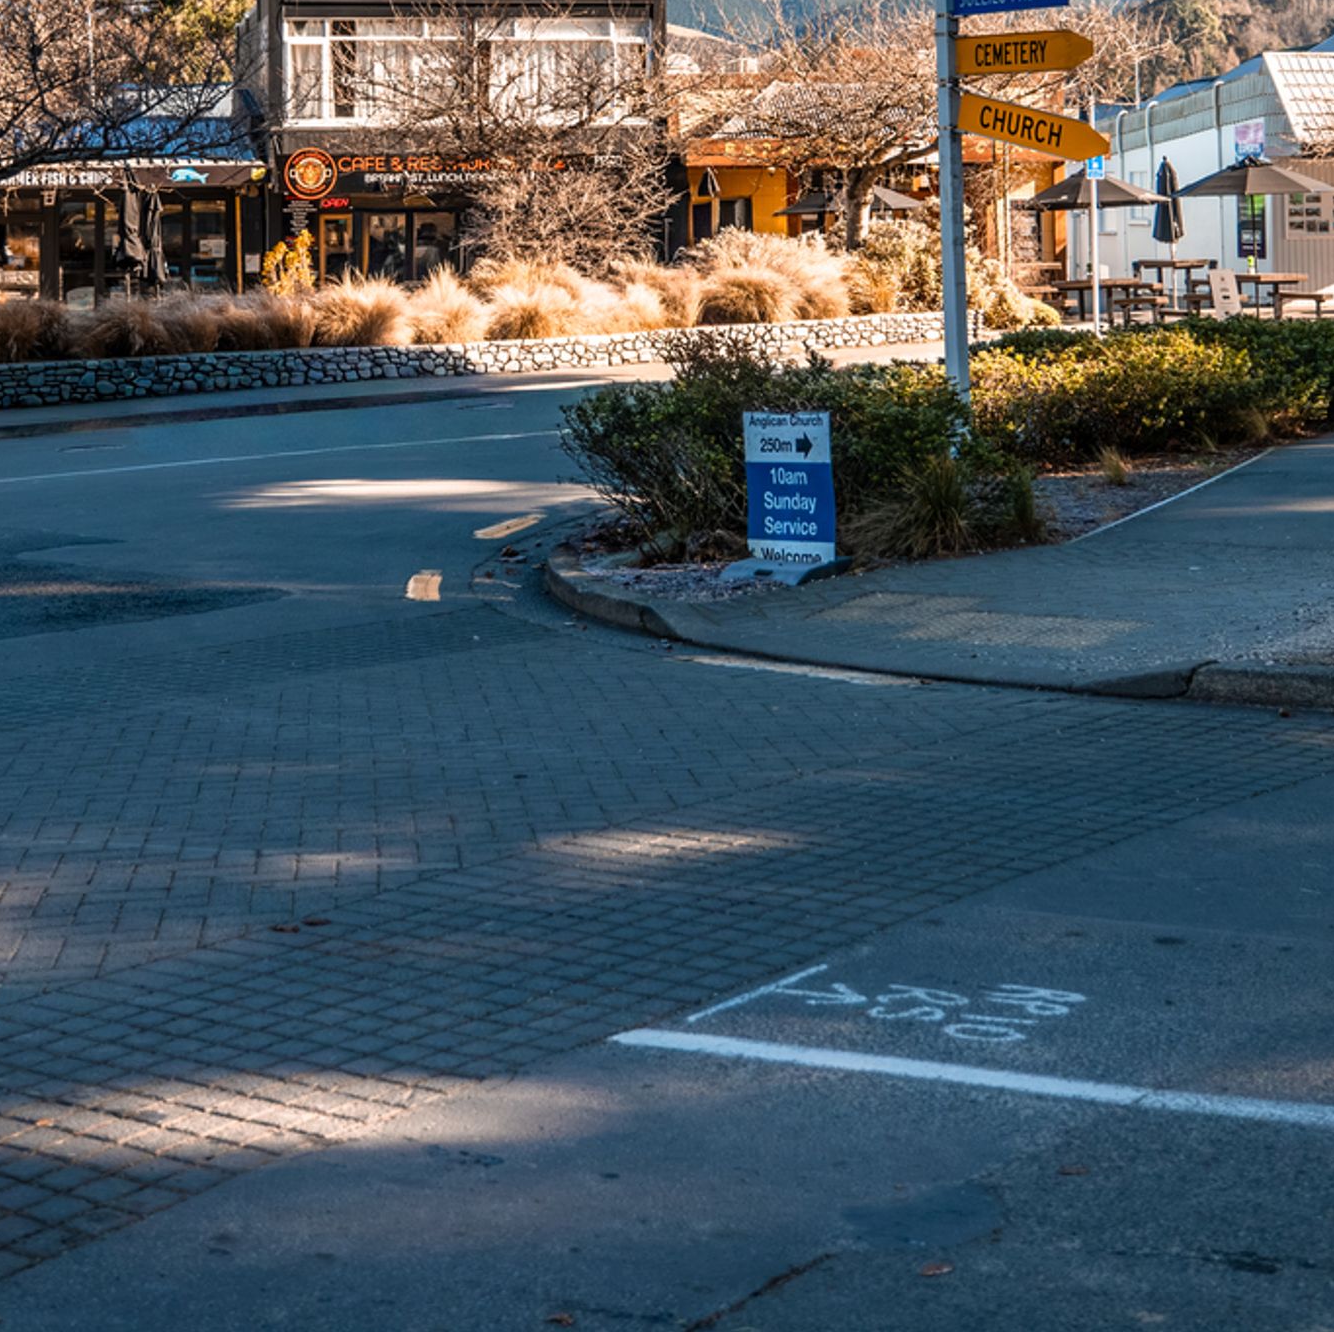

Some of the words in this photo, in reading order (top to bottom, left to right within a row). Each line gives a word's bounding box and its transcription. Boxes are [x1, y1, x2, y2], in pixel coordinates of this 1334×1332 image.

[975, 40, 1048, 67] CEMETERY
[979, 105, 1063, 148] CHURCH
[337, 156, 386, 173] CAFE
[390, 157, 404, 171] &
[41, 171, 67, 186] FISH
[79, 171, 113, 185] CHIPS
[320, 198, 349, 209] OPEN
[749, 415, 788, 429] Anglican
[789, 415, 824, 427] Church
[760, 437, 793, 453] 250m
[770, 468, 808, 485] 10am
[764, 491, 817, 514] Sunday
[764, 516, 817, 536] Service
[761, 548, 822, 564] Welcome
